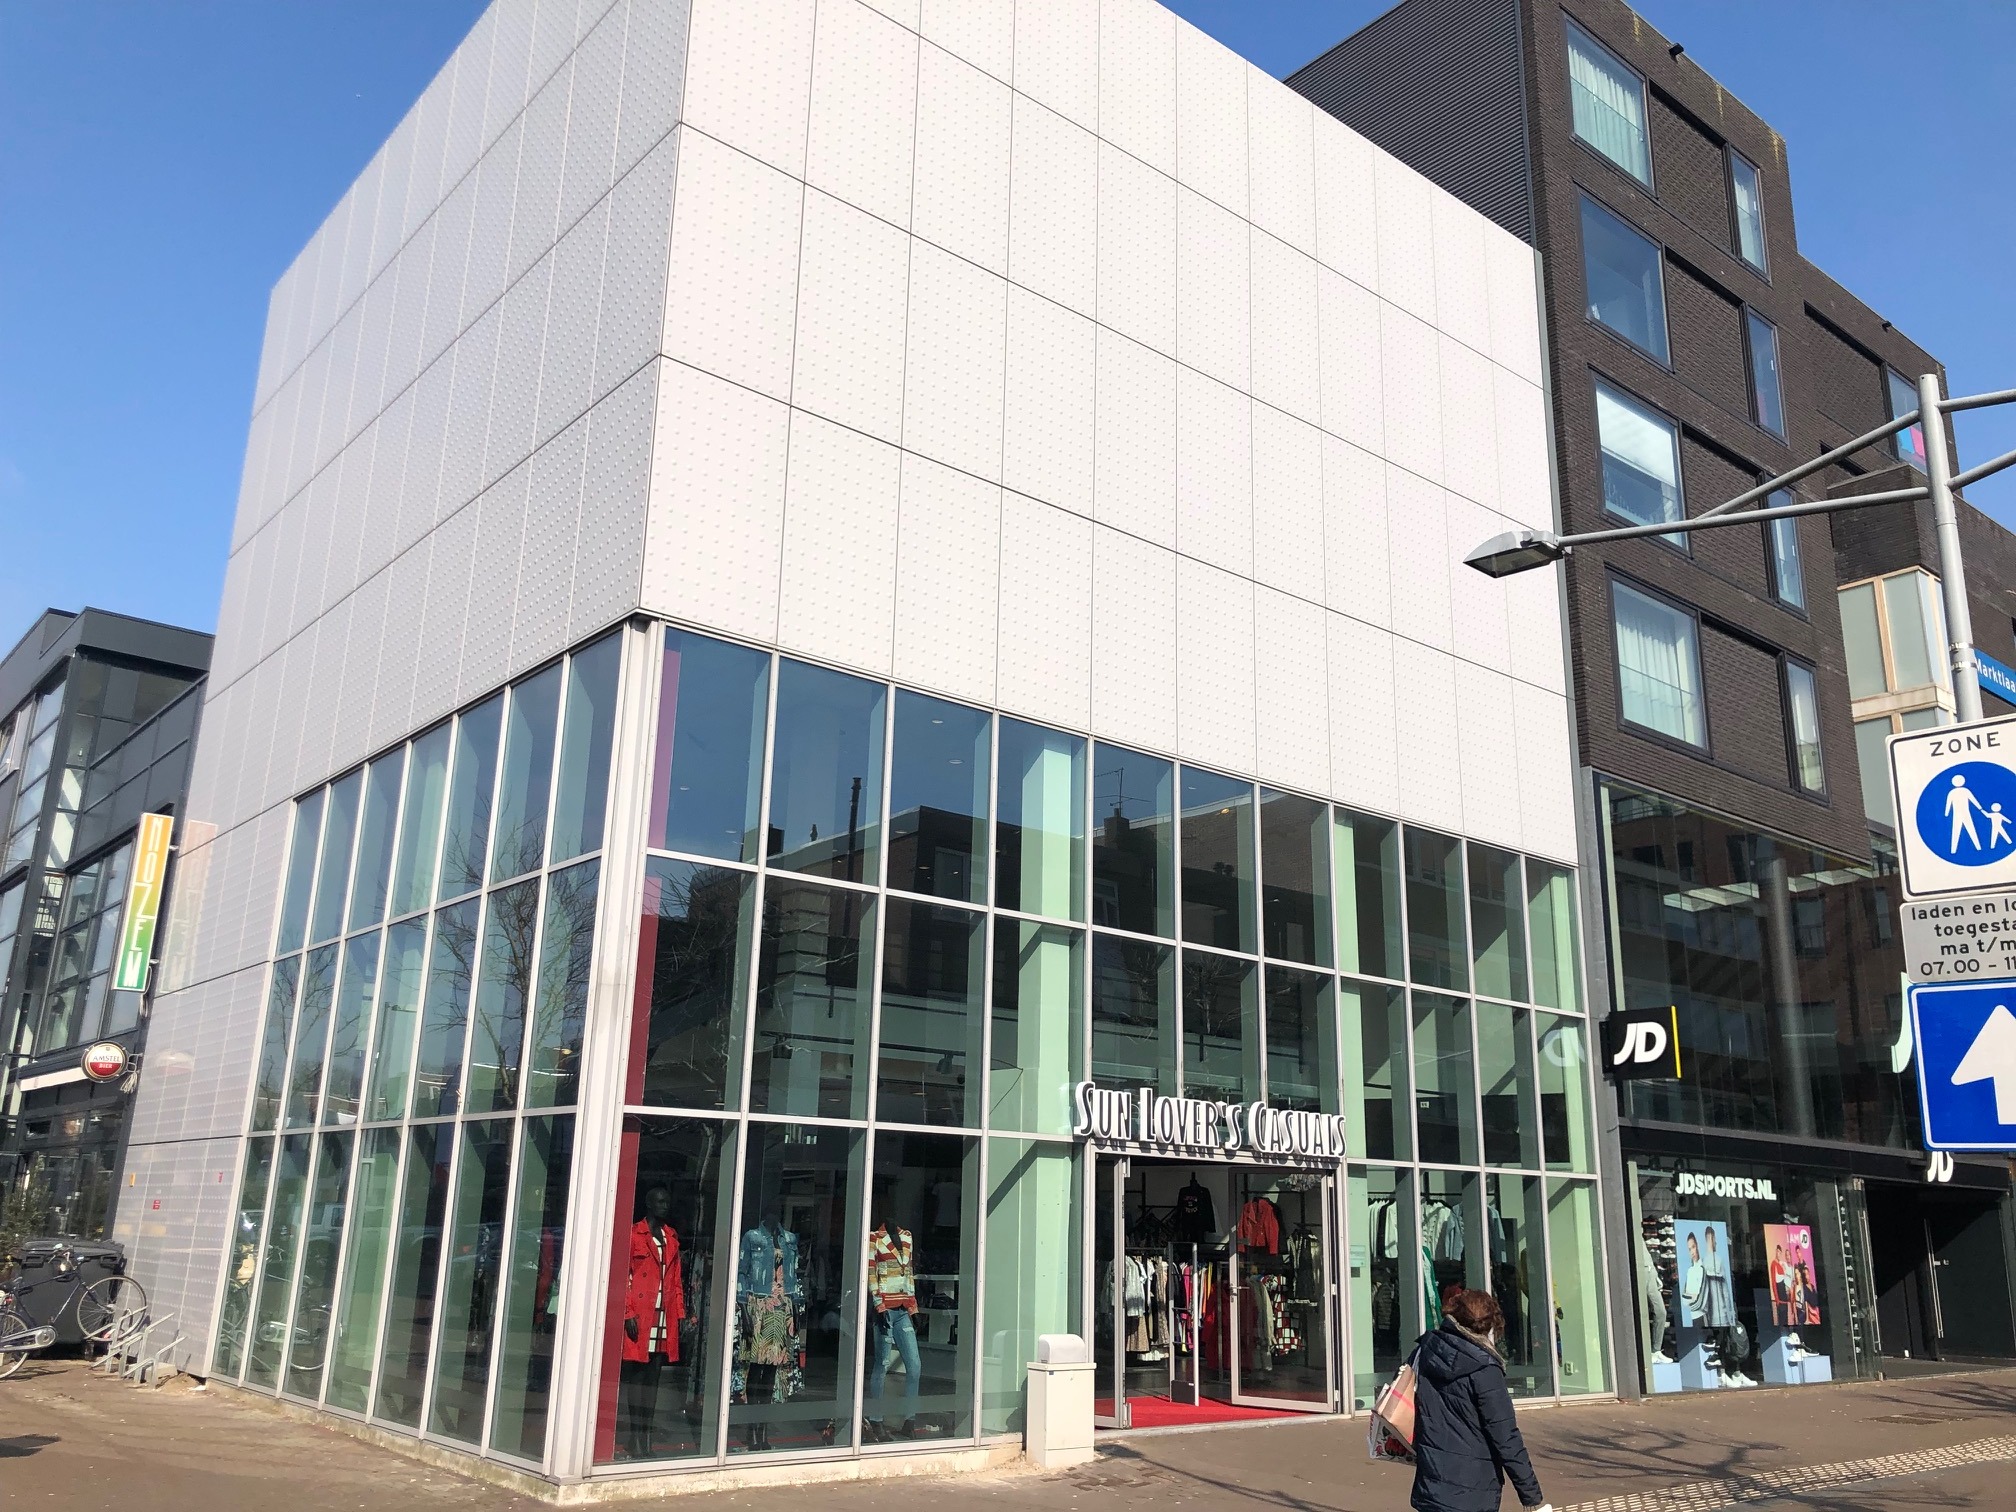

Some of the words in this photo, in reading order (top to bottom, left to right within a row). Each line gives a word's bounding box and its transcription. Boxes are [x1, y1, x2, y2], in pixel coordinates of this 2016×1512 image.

[1929, 731, 2001, 757] ZONE
[1911, 904, 1965, 921] laden
[1972, 902, 1996, 915] en
[1940, 943, 1969, 956] ma
[1976, 936, 2016, 954] t/m
[1920, 958, 1980, 976] 07.00
[1613, 1021, 1667, 1066] JD
[1675, 1172, 1777, 1201] JDSPORTS.NL
